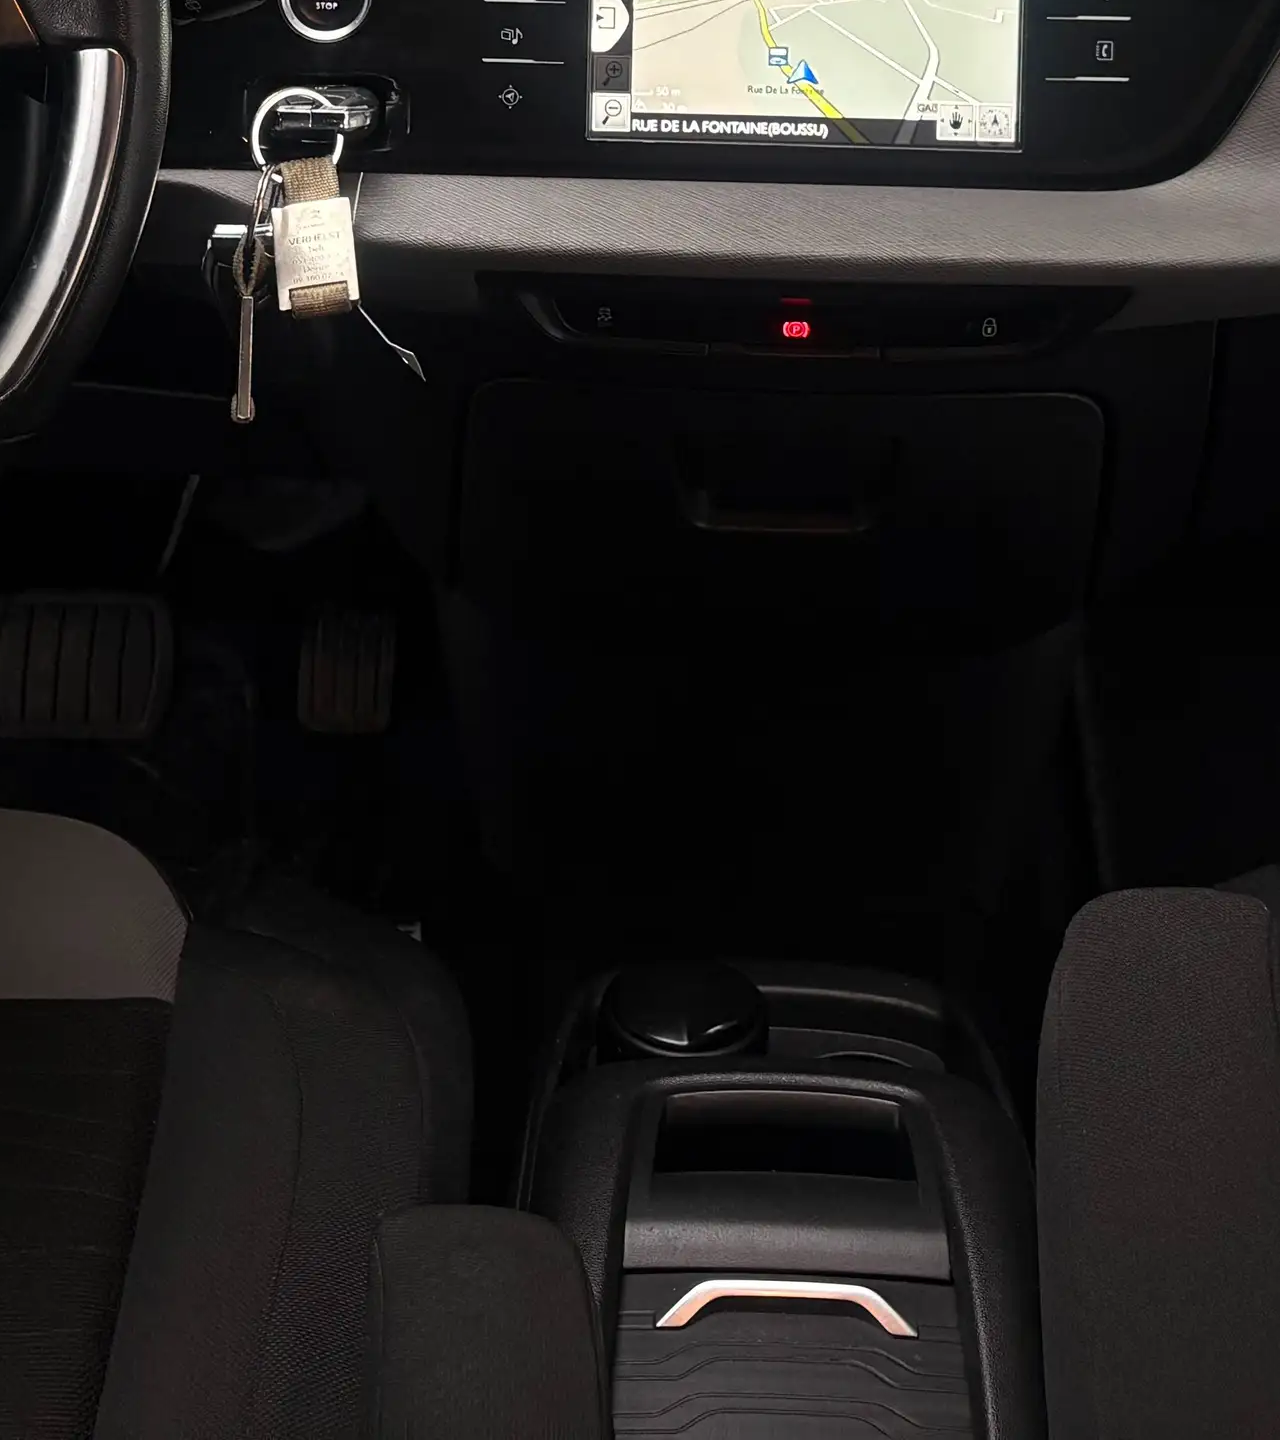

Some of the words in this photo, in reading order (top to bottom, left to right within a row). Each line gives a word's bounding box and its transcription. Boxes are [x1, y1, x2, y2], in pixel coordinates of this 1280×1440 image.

[315, 2, 338, 10] STOP
[747, 85, 763, 94] Rue
[765, 85, 777, 94] De
[780, 86, 789, 94] La
[632, 119, 658, 132] RUE
[660, 120, 679, 133] DE
[682, 120, 700, 133] LA
[702, 121, 829, 139] FONTAINE(BOUSSU)
